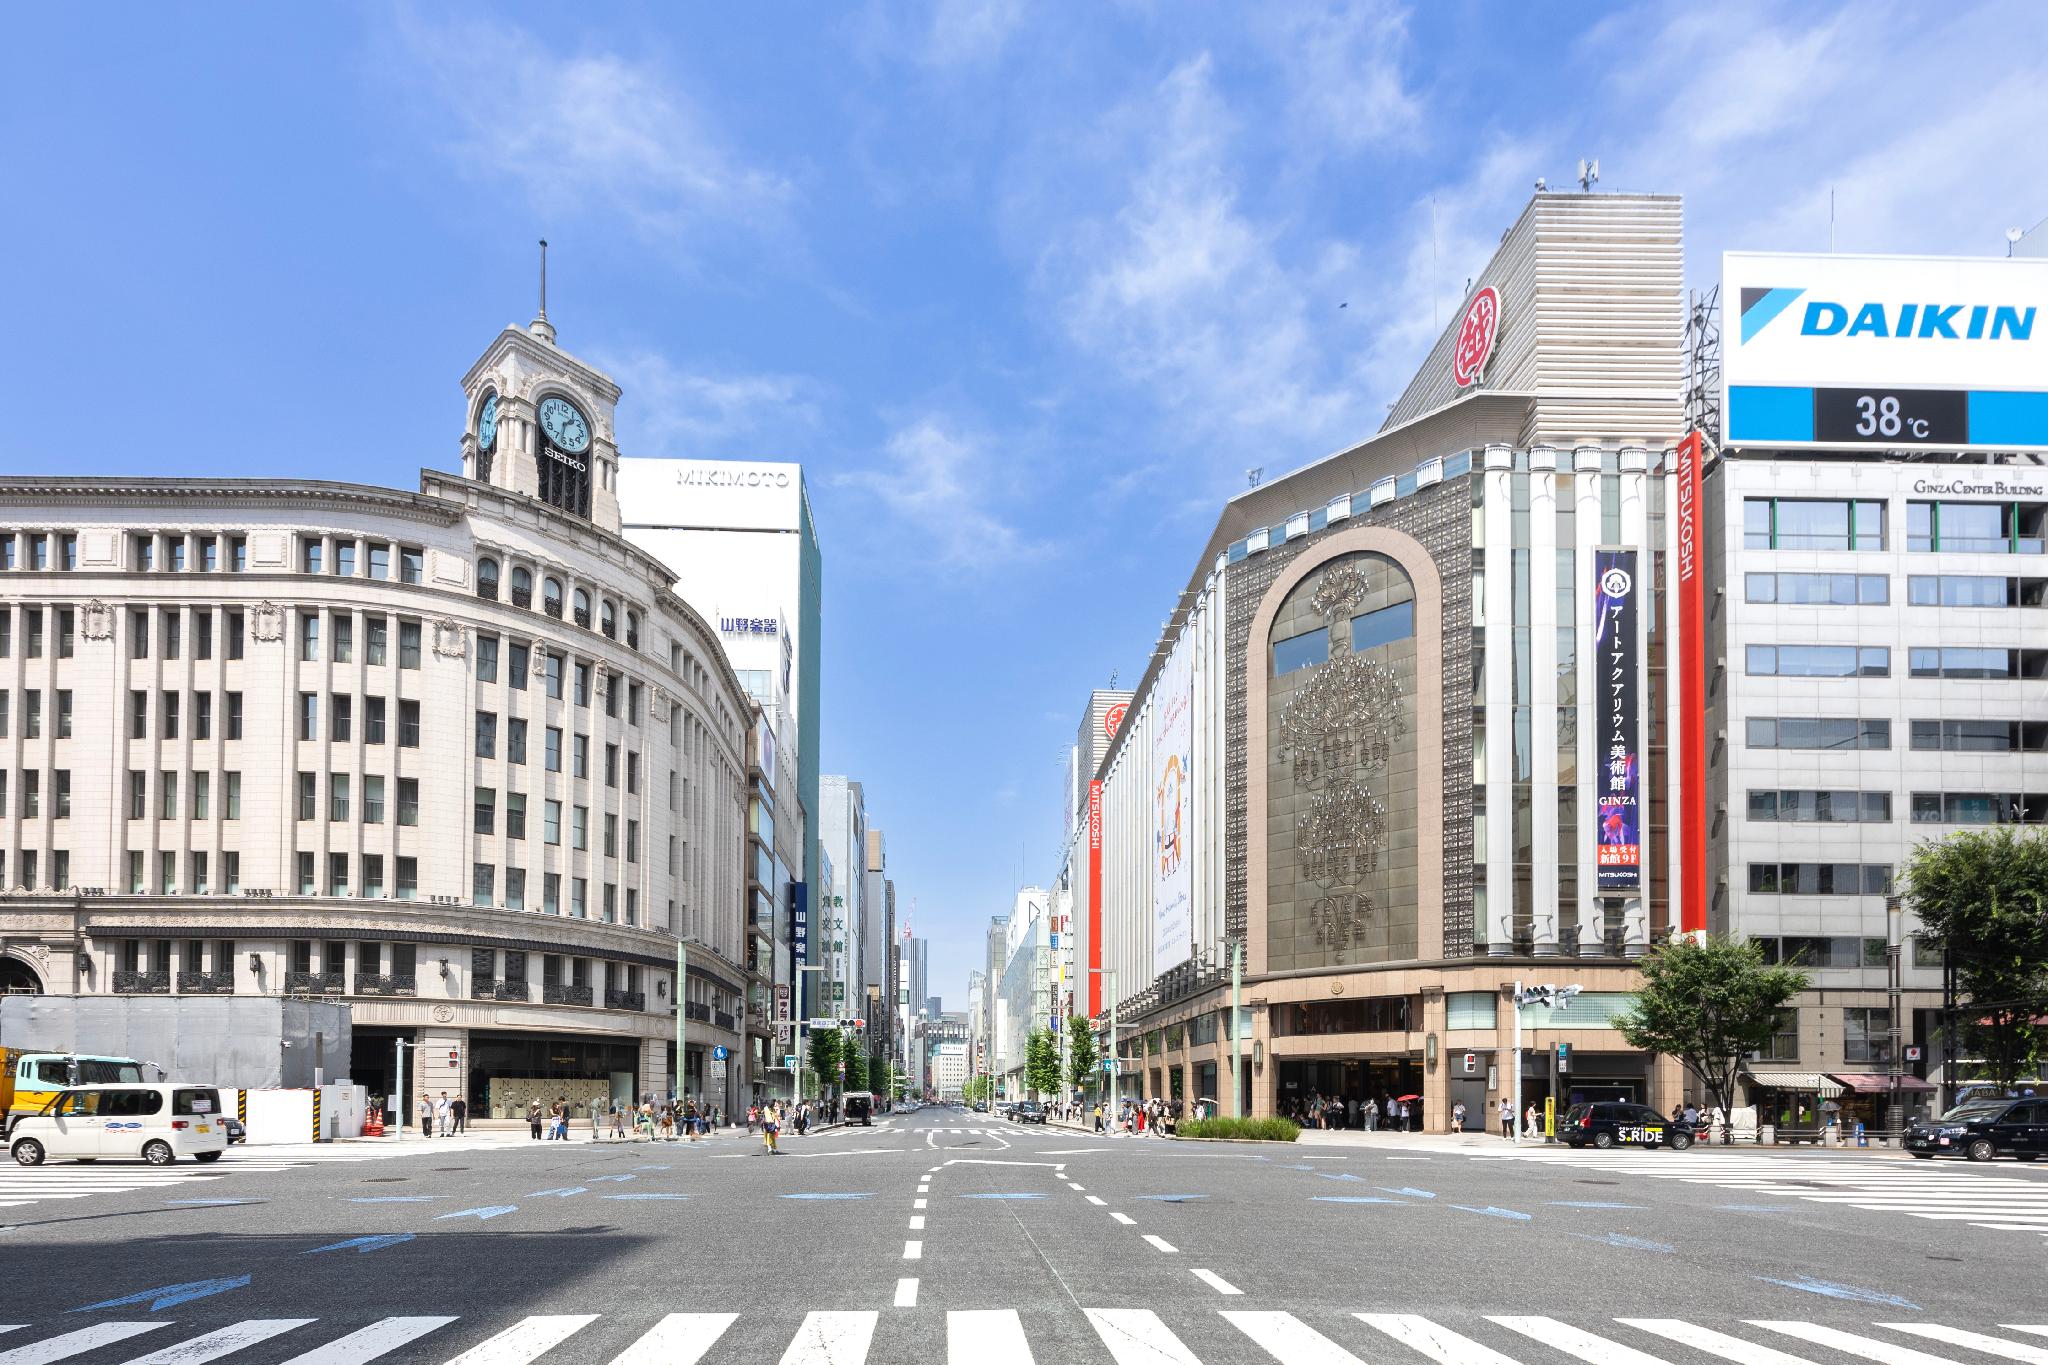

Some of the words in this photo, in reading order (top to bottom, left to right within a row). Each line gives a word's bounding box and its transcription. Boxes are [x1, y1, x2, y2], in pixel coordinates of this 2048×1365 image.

[1800, 301, 2037, 341] DAIKIN
[546, 405, 554, 414] 10
[553, 402, 560, 411] 11
[561, 404, 569, 414] 12
[544, 412, 550, 420] 9
[1856, 396, 1902, 436] 38
[547, 422, 554, 430] 8
[575, 419, 582, 428] 2
[554, 430, 560, 439] 7
[561, 436, 567, 445] 6
[569, 438, 575, 447] 5
[575, 436, 581, 444] 4
[545, 447, 586, 472] SEIKO
[676, 468, 790, 488] MIKIMOTO
[1680, 445, 1693, 582] MITSUKOSHI
[720, 617, 777, 634] 山野楽器
[1610, 606, 1626, 791] アートアクアリウム美術館
[1599, 796, 1636, 806] GINZA
[1091, 784, 1100, 849] MITSUKOSHI
[833, 895, 844, 953] 教文館
[1618, 1131, 1663, 1142] S.RIDE
